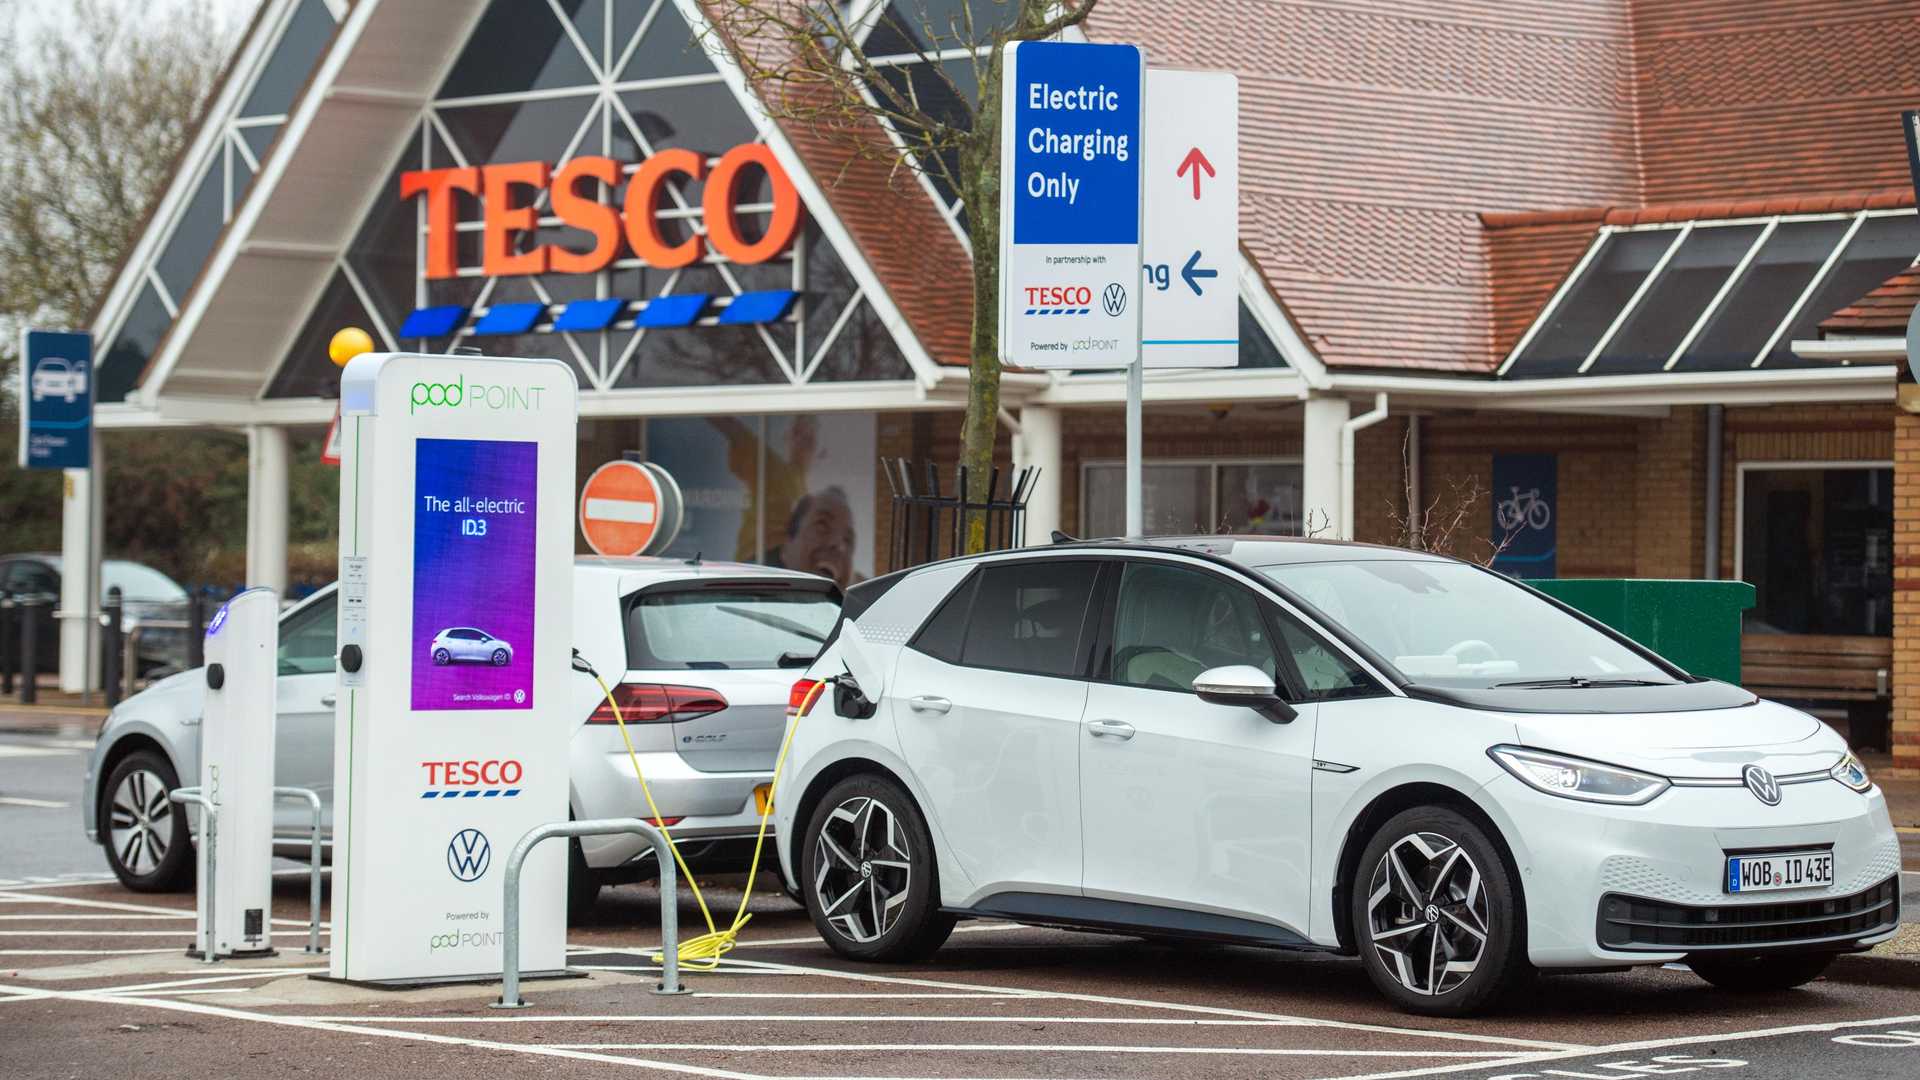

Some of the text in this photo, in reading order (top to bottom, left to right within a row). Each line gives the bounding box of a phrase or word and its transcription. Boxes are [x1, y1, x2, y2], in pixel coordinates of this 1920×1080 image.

[1029, 83, 1119, 111] Electric
[1028, 127, 1129, 161] Charging
[1028, 171, 1080, 205] Only
[401, 143, 799, 280] TESCO
[1045, 255, 1107, 266] In partnership with
[1024, 286, 1092, 306] TESCO
[1030, 336, 1119, 352] Powered by pod POINT
[411, 373, 545, 416] pod POINT
[424, 496, 525, 514] The all-electric
[422, 760, 523, 785] TESCO
[1732, 878, 1738, 887] D
[1742, 857, 1831, 887] WOB ID 43E
[446, 911, 489, 921] Powered by
[430, 928, 504, 955] pod POINT
